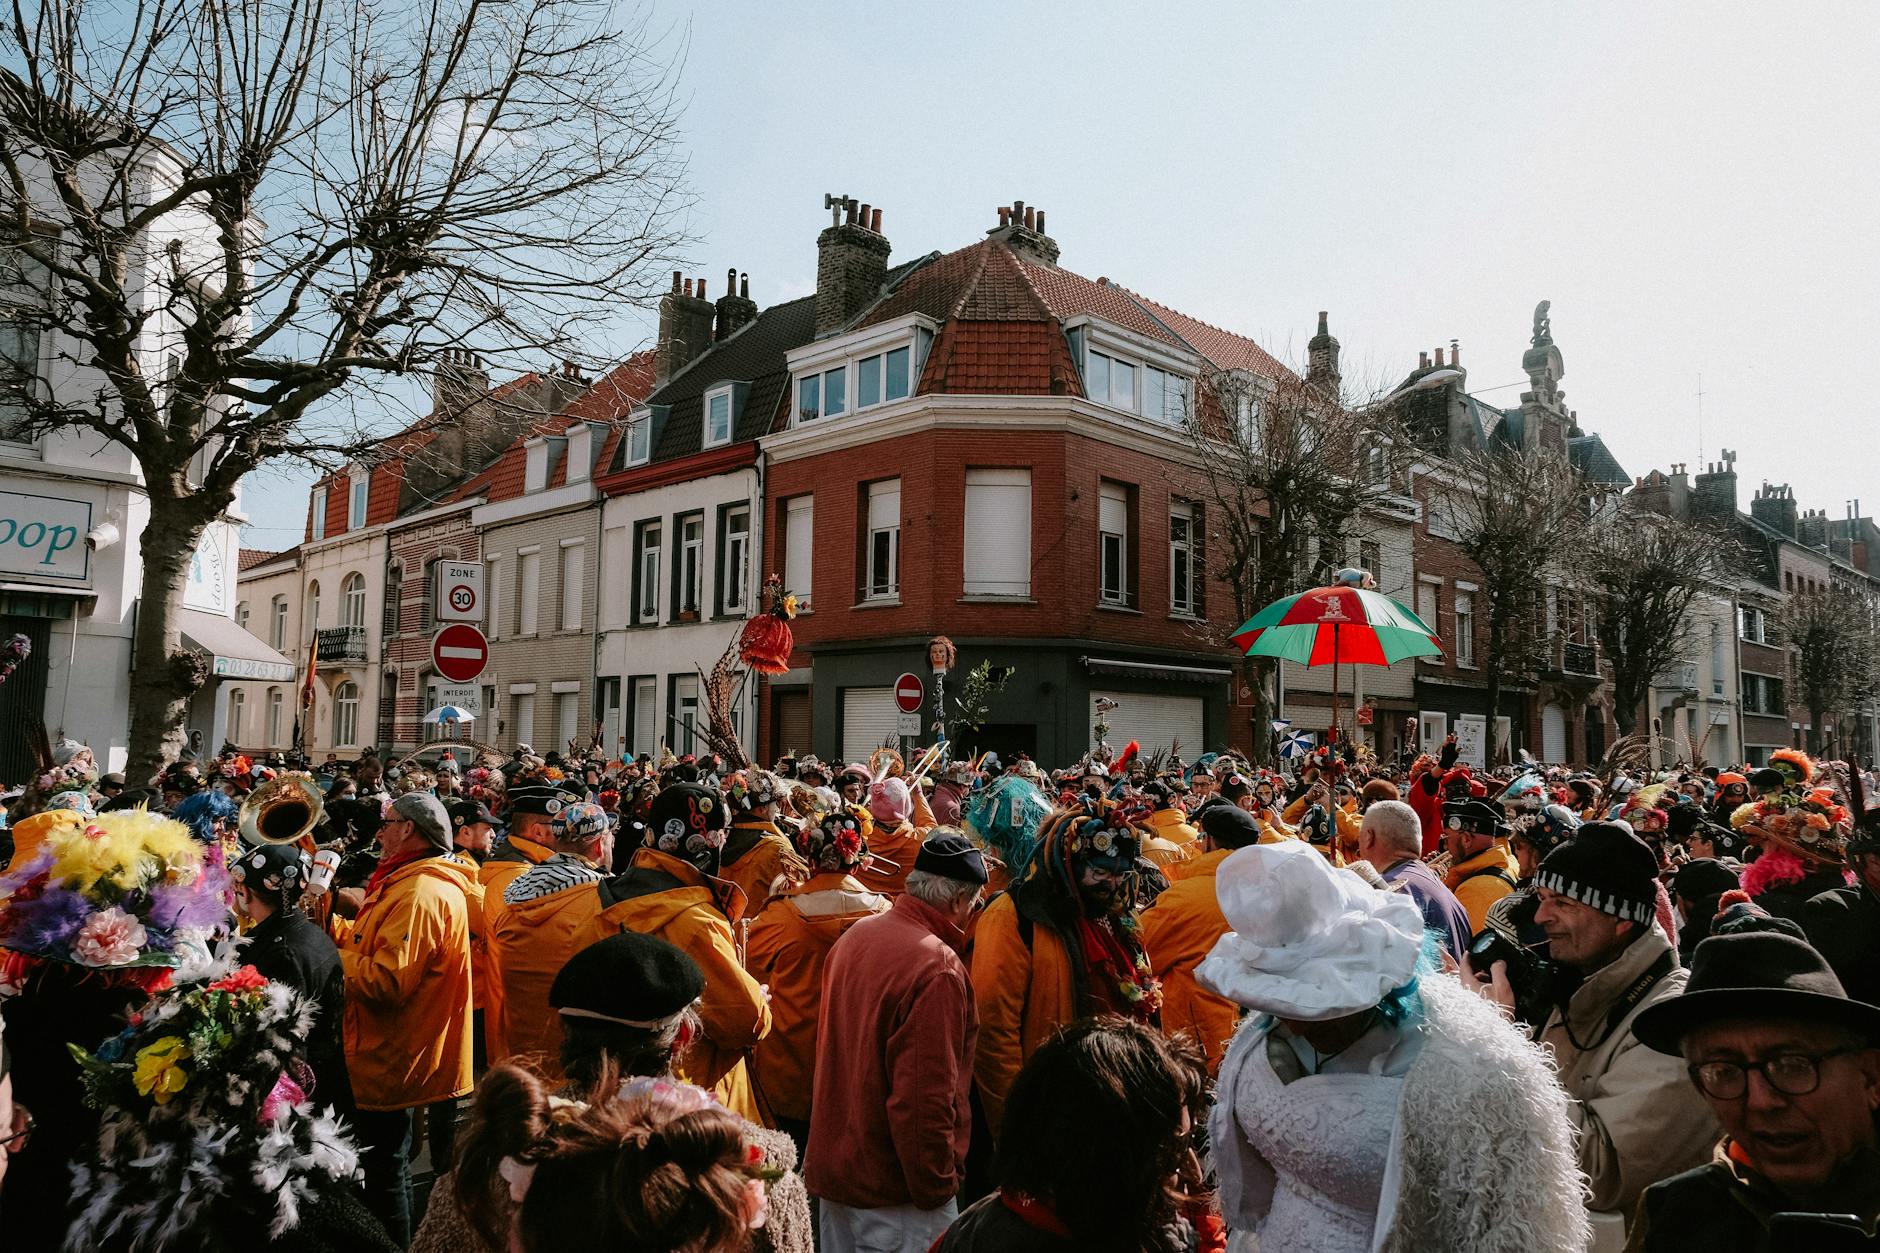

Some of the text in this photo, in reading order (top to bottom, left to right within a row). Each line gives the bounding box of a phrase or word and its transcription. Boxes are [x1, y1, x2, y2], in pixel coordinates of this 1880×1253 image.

[450, 568, 476, 578] ZONE
[454, 592, 471, 605] 30
[244, 662, 257, 676] 28
[443, 689, 474, 697] INTERDIT
[1626, 975, 1655, 1003] Nikon
